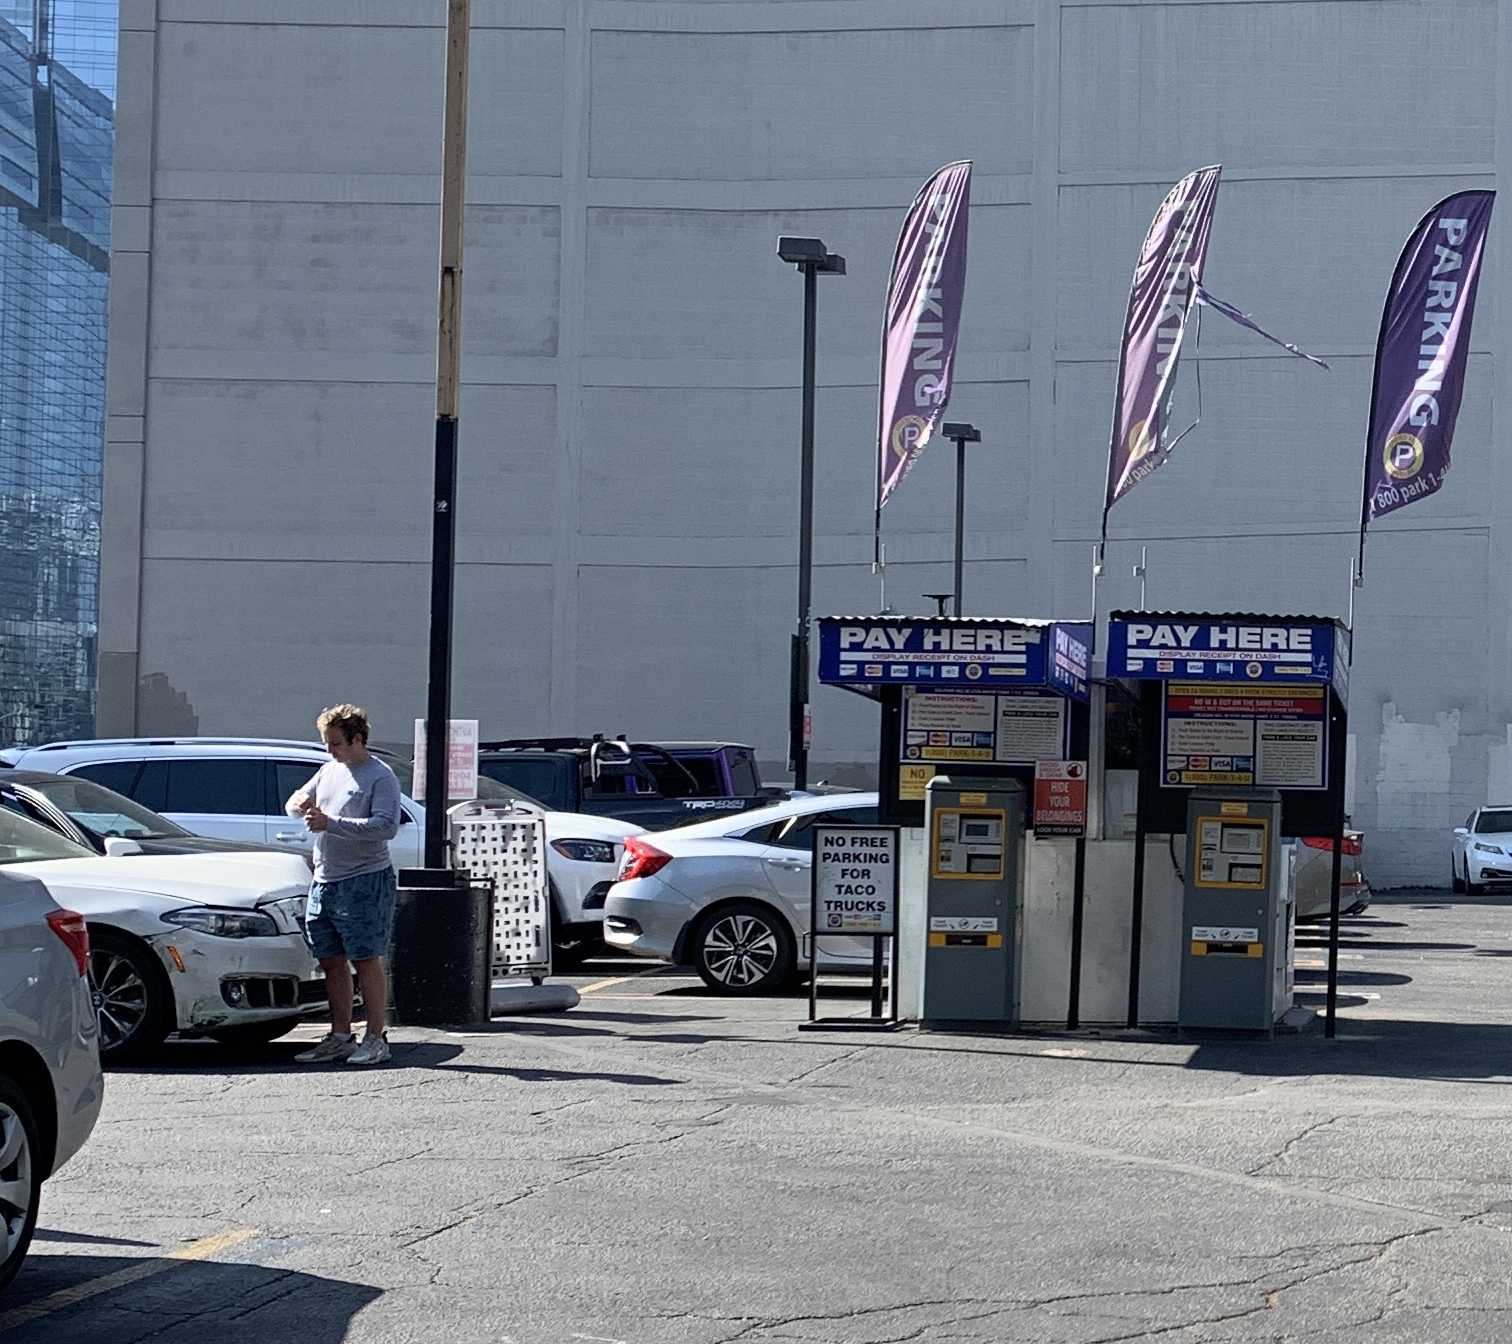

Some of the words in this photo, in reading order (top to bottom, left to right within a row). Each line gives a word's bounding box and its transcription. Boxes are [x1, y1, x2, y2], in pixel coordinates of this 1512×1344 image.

[1408, 216, 1468, 428] PARKING
[1395, 444, 1415, 467] P
[1376, 487, 1400, 508] 800
[1400, 476, 1430, 503] park
[839, 626, 912, 650] PAY
[922, 628, 1027, 652] HERE
[1127, 623, 1199, 647] PAY
[1209, 625, 1312, 650] HERE
[872, 653, 911, 661] DISPLAY
[1159, 650, 1198, 658] DISPLAY
[1199, 651, 1237, 659] RECEIPT
[1239, 652, 1254, 660] ON
[953, 735, 971, 743] VISA
[1213, 759, 1231, 767] VISA
[910, 768, 926, 779] NO
[1050, 781, 1070, 793] HIDE
[1049, 795, 1071, 807] YOUR
[1036, 809, 1083, 822] BELONGINGS
[824, 836, 846, 847] NO
[851, 837, 889, 848] FREE
[822, 852, 890, 864] PARKING
[841, 868, 871, 879] FOR
[834, 884, 876, 895] TACO
[824, 900, 886, 912] TRUCKS
